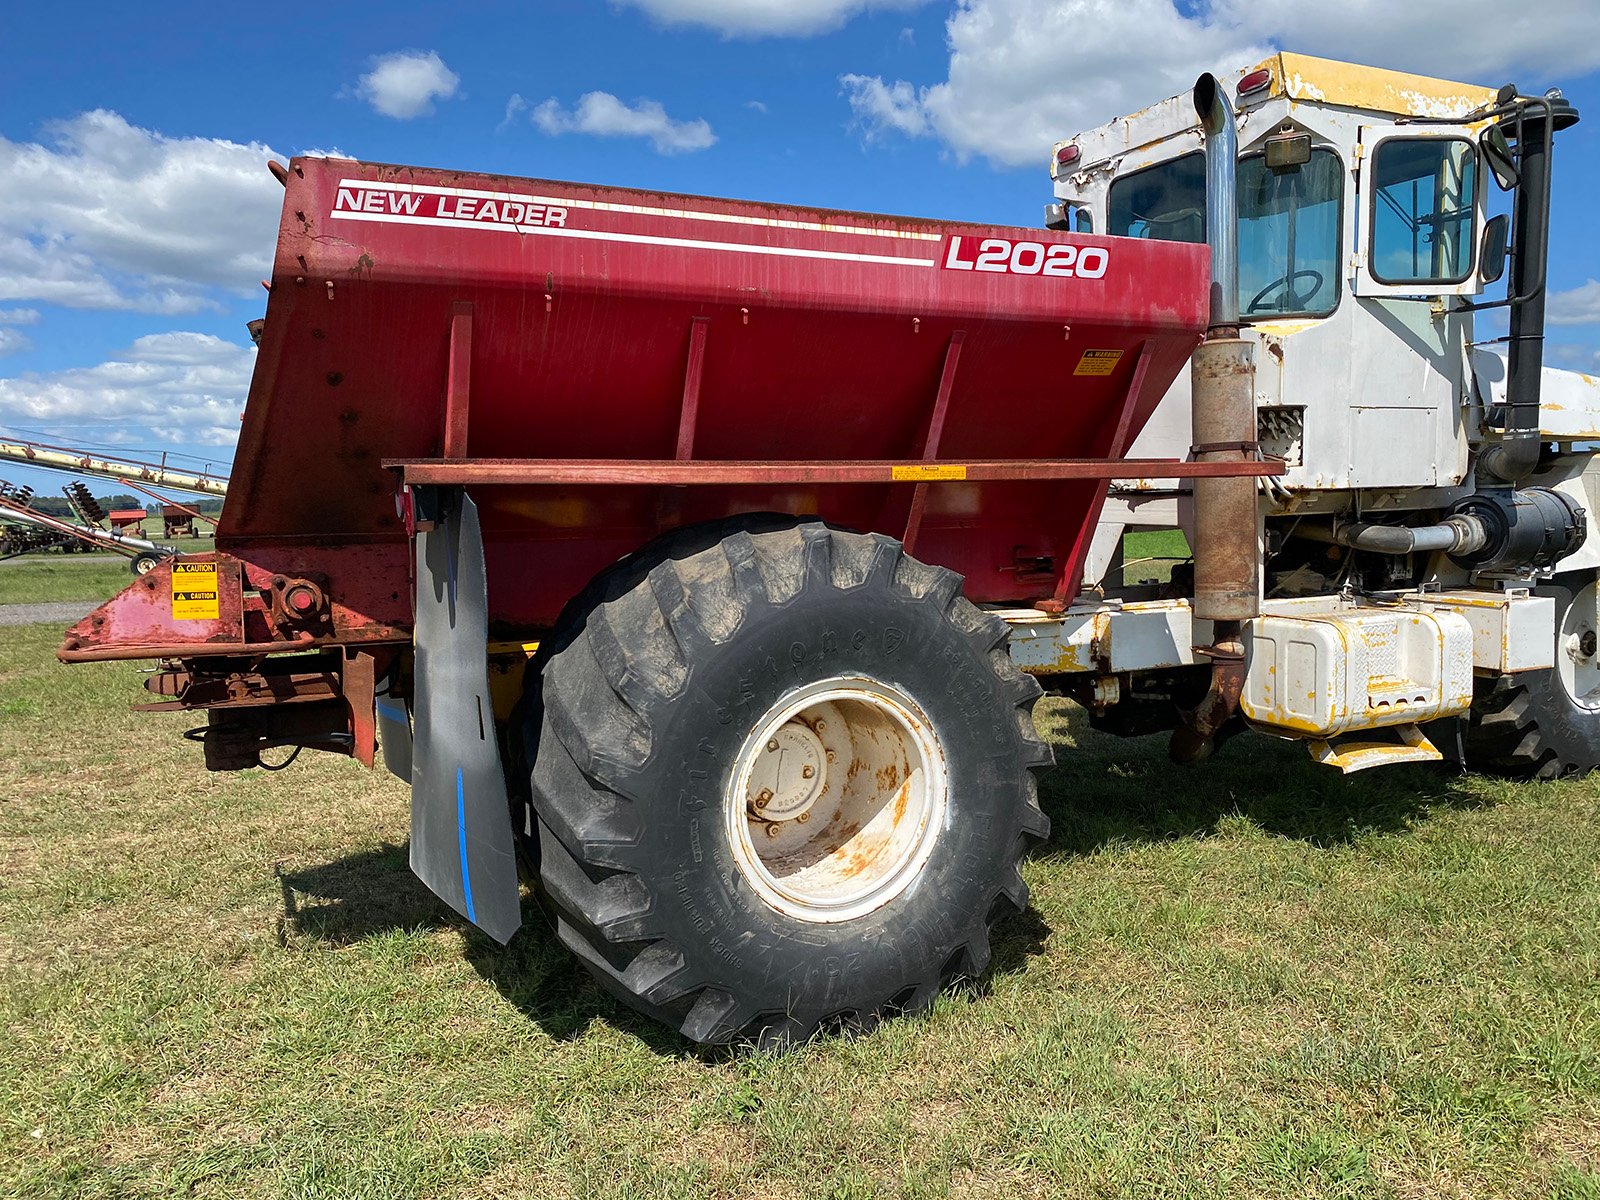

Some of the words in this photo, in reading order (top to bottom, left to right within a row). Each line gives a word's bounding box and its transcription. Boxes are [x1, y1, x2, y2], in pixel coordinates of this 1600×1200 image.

[335, 188, 424, 215] NEW
[436, 196, 569, 228] LEADER
[945, 236, 1109, 279] L2020
[186, 564, 213, 572] CAUTION
